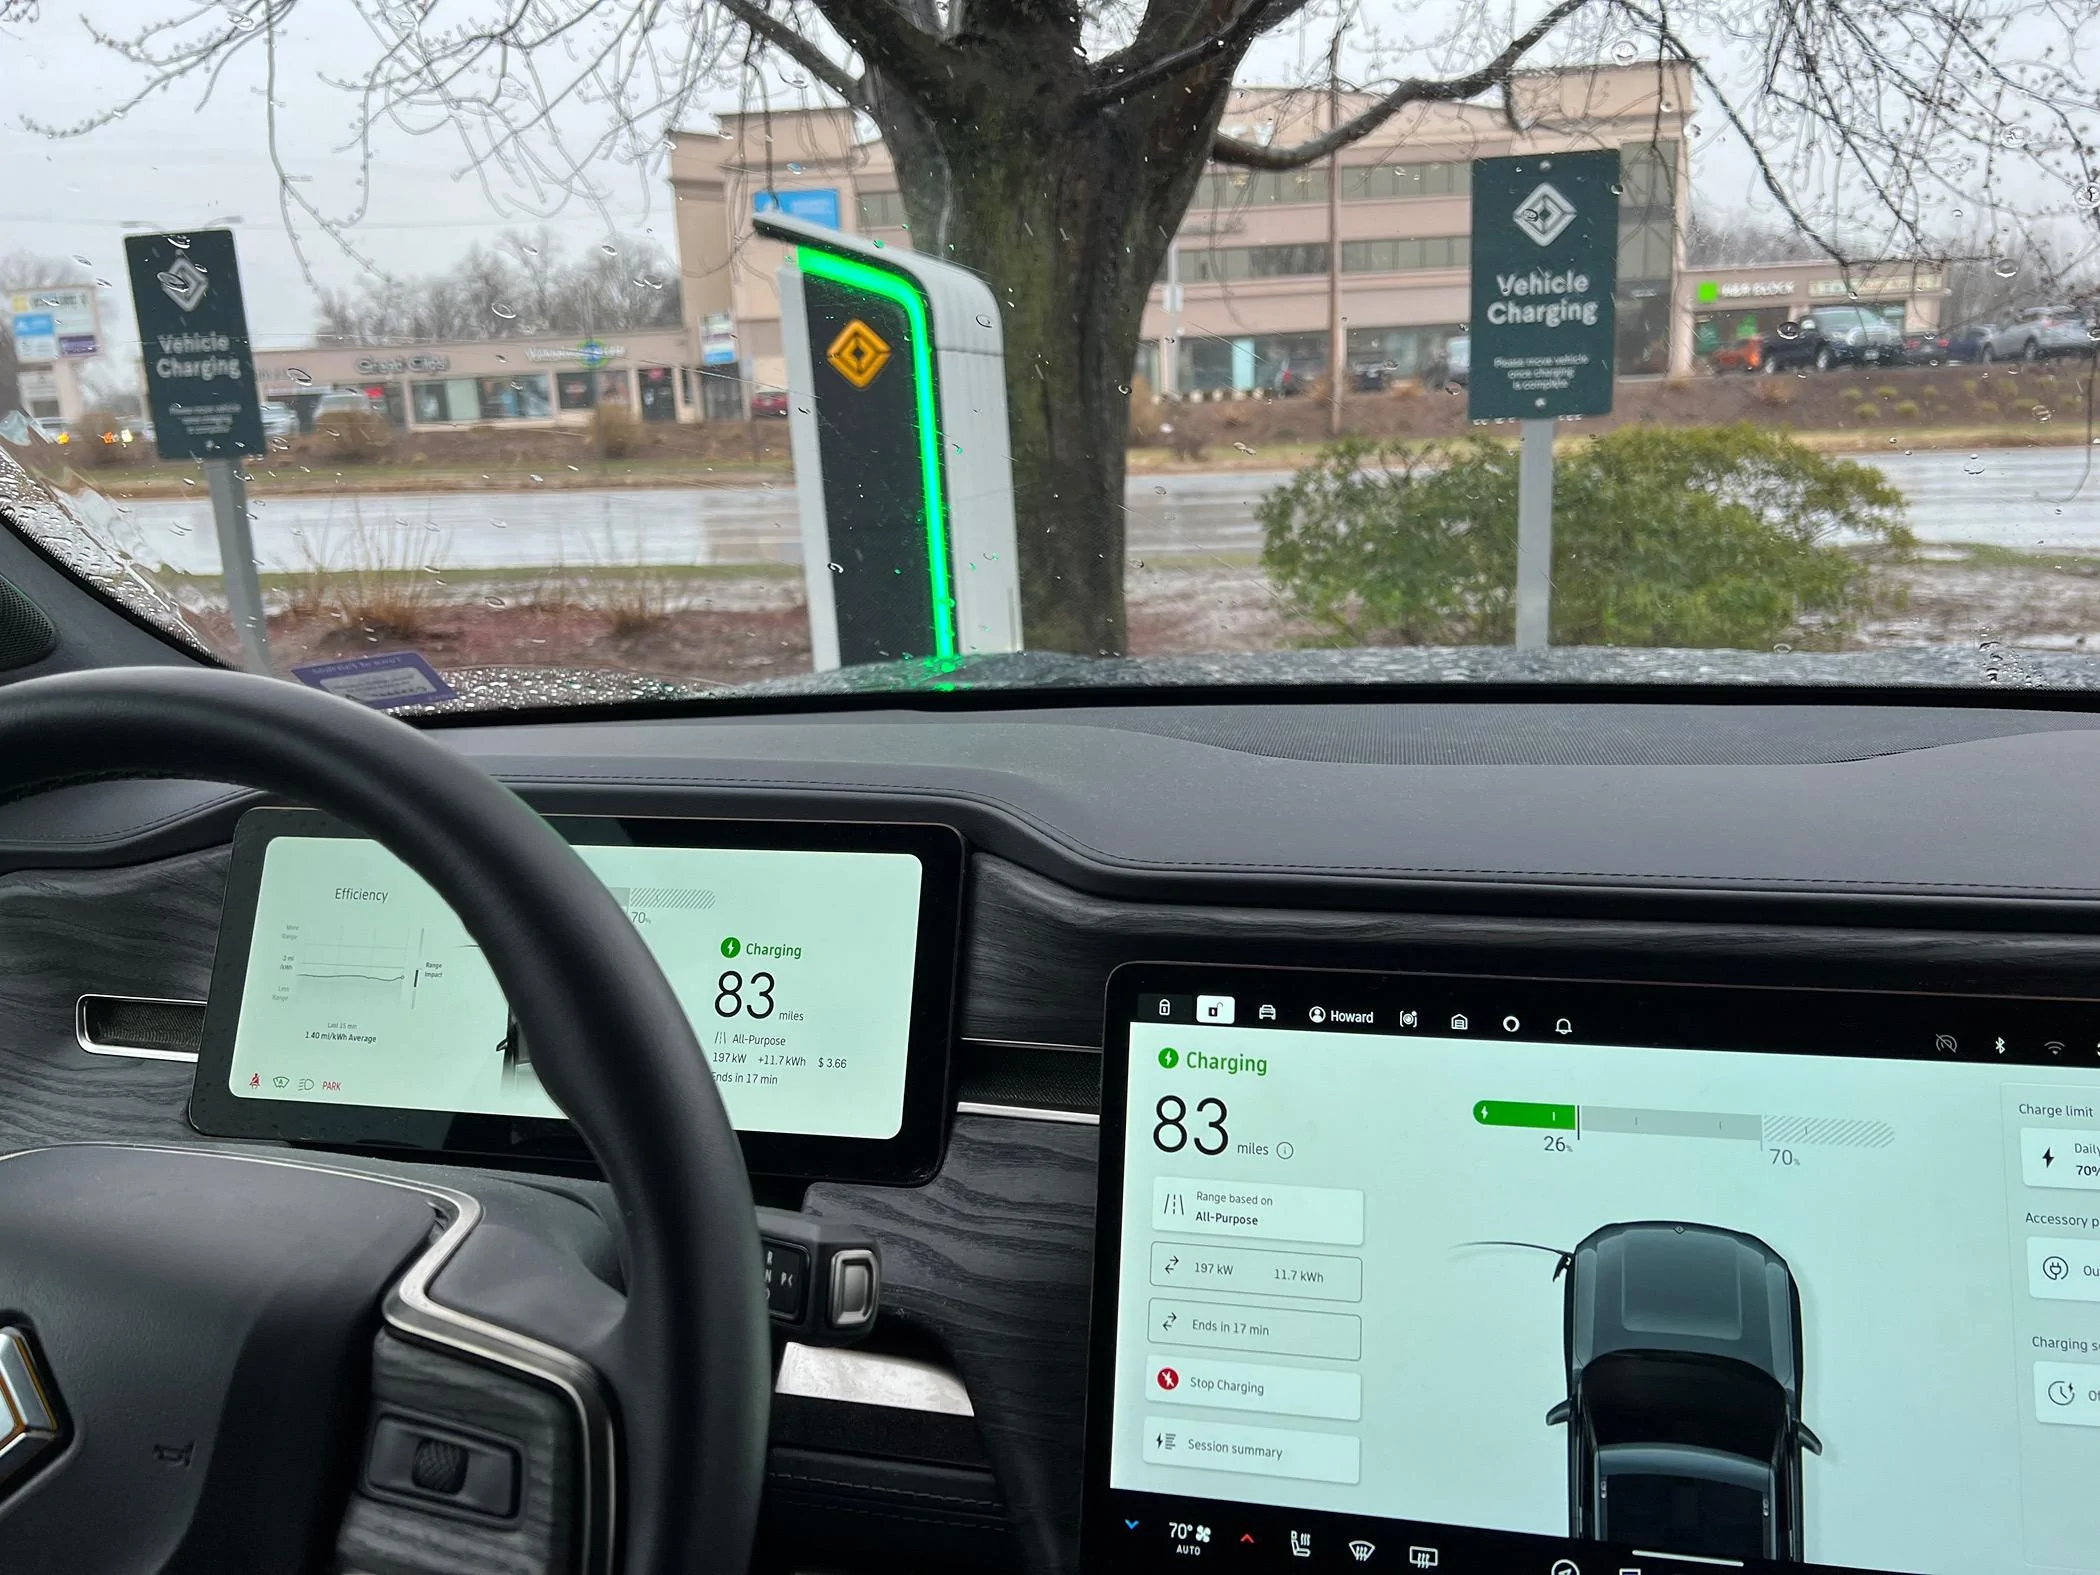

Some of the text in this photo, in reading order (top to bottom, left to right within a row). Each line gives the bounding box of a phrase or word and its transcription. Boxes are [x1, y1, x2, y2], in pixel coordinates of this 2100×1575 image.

[1496, 269, 1590, 296] Vehicle
[1487, 298, 1599, 327] Charging
[157, 331, 230, 354] Vehicle
[156, 355, 242, 381] Charging
[334, 887, 389, 904] Efficiency
[746, 943, 802, 959] Charging
[425, 962, 443, 970] Range
[424, 971, 443, 979] Impact
[714, 970, 804, 1021] 83 miles
[1330, 1009, 1374, 1025] Howard
[304, 1031, 377, 1044] 1.40 mi/kWh Average
[732, 1034, 786, 1047] All-Purpose
[713, 1052, 747, 1064] 197 kW
[757, 1055, 807, 1067] +11.7 kWh
[826, 1058, 847, 1069] 3.66
[1185, 1050, 1268, 1077] Charging
[322, 1080, 341, 1091] PARK
[735, 1073, 744, 1083] in
[746, 1073, 758, 1084] 17
[760, 1074, 778, 1084] min
[2018, 1103, 2093, 1118] Charge limit
[1152, 1095, 1270, 1156] 83 miles
[1196, 1191, 1273, 1207] Range based on
[1195, 1211, 1259, 1228] All-Purpose
[2025, 1212, 2088, 1229] Accessory
[1194, 1261, 1234, 1275] 197 kW
[1274, 1268, 1324, 1283] 11.7 kWh
[1192, 1319, 1270, 1336] Ends in 17 min
[2032, 1336, 2088, 1353] Charging
[1190, 1377, 1265, 1397] Stop Charging
[1188, 1438, 1283, 1461] Session summary
[1168, 1521, 1193, 1540] 70°
[1176, 1544, 1201, 1556] AUTO
